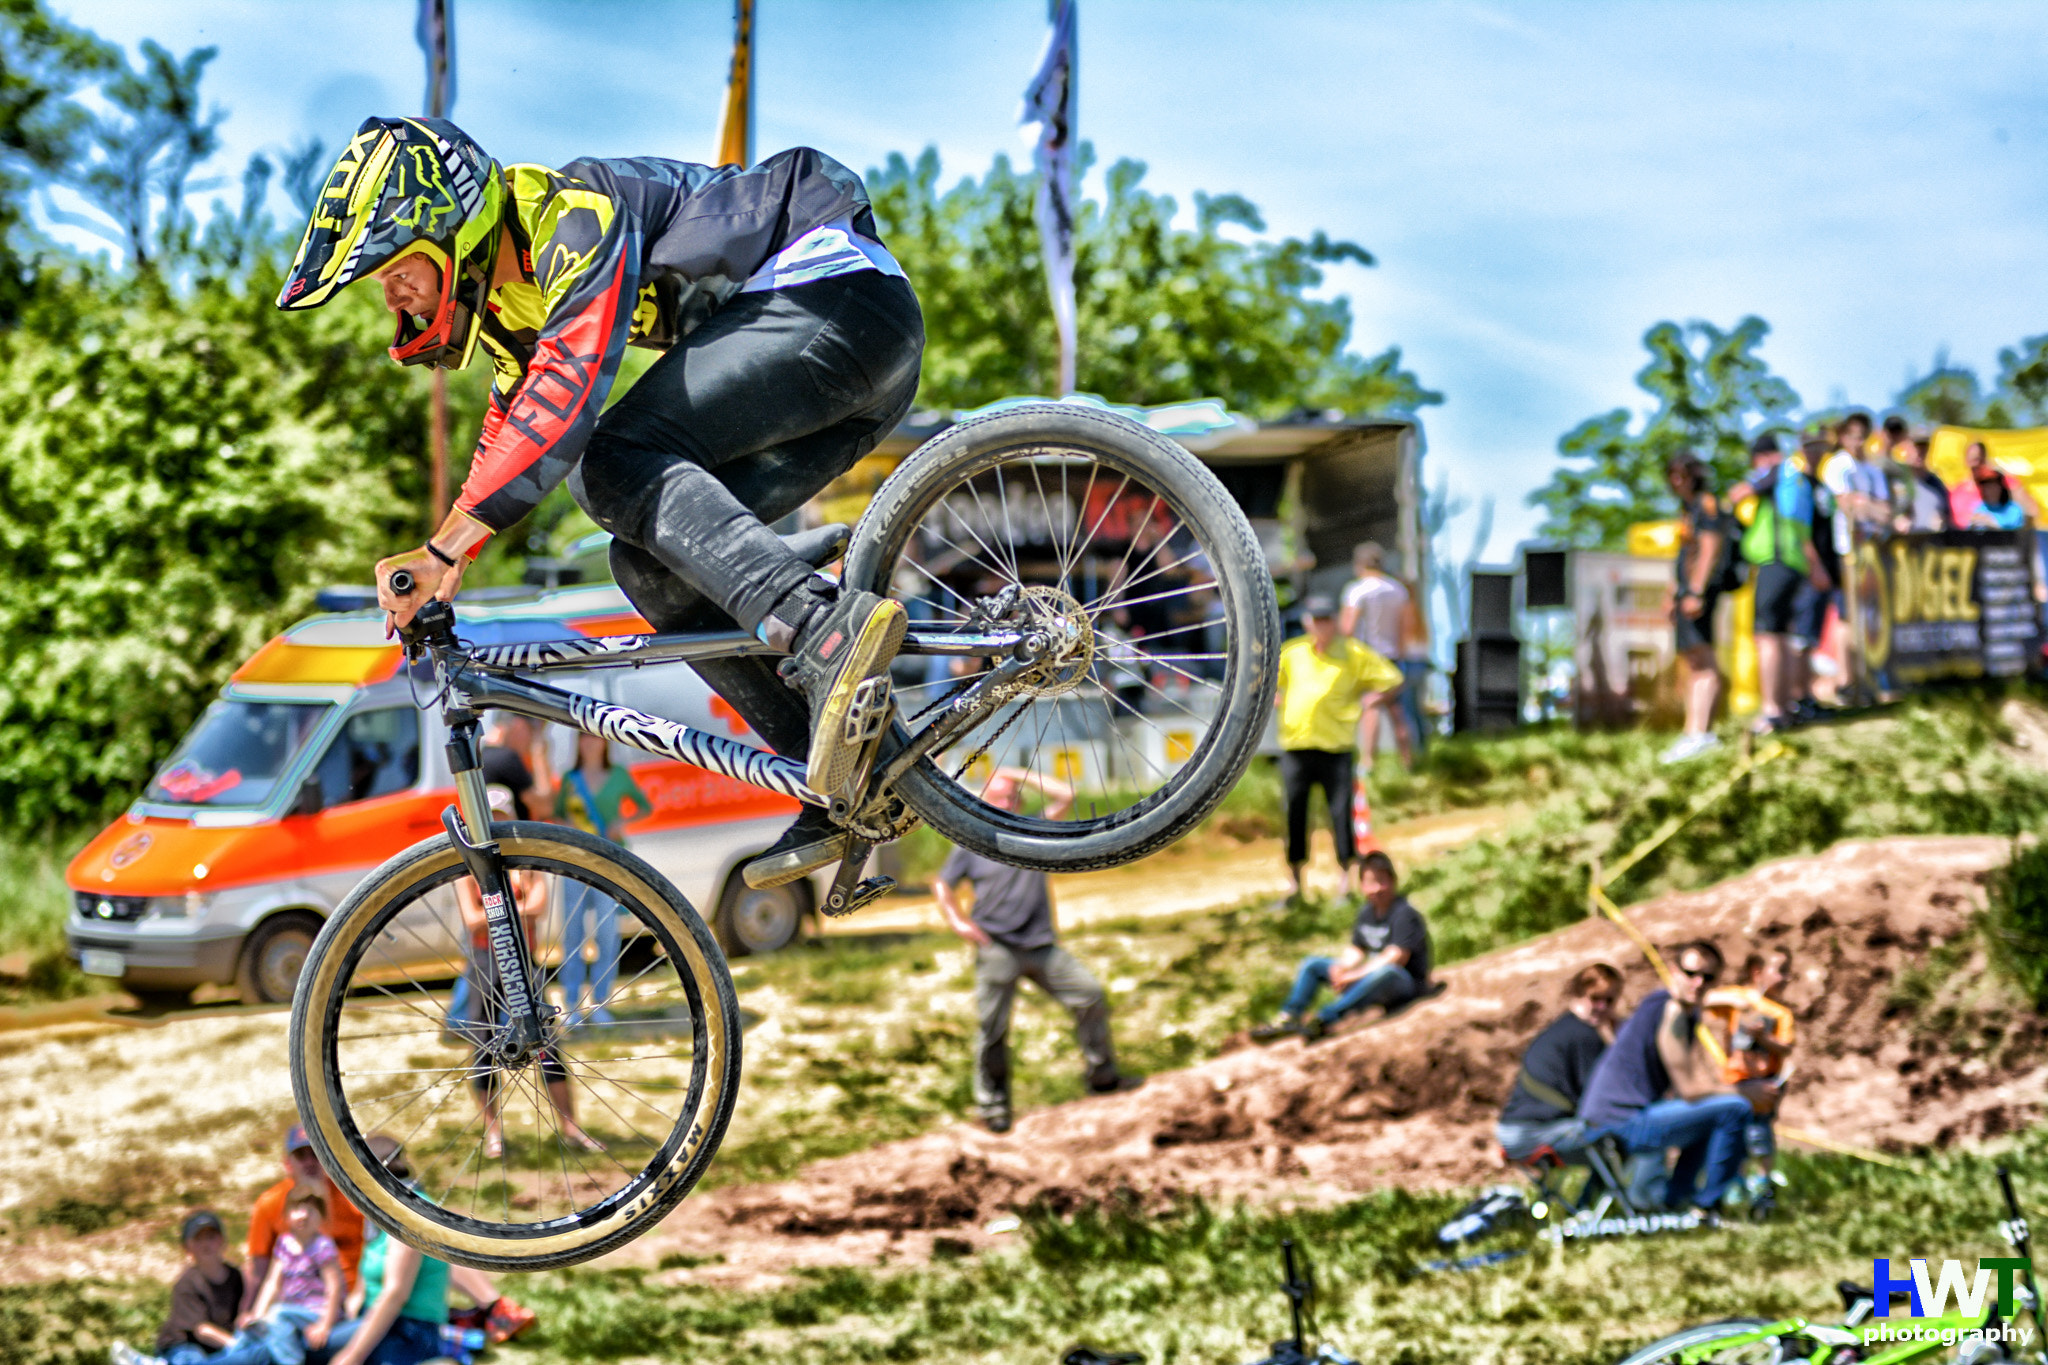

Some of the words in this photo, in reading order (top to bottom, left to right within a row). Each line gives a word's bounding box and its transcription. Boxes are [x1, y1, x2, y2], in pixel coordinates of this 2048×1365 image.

[314, 130, 380, 229] FOX
[507, 337, 600, 448] FOX
[873, 486, 912, 544] RACE
[484, 894, 503, 907] ROCK
[486, 905, 506, 919] SHOX
[489, 922, 532, 1019] ROCKSHOX
[624, 1122, 704, 1221] MAXXIS
